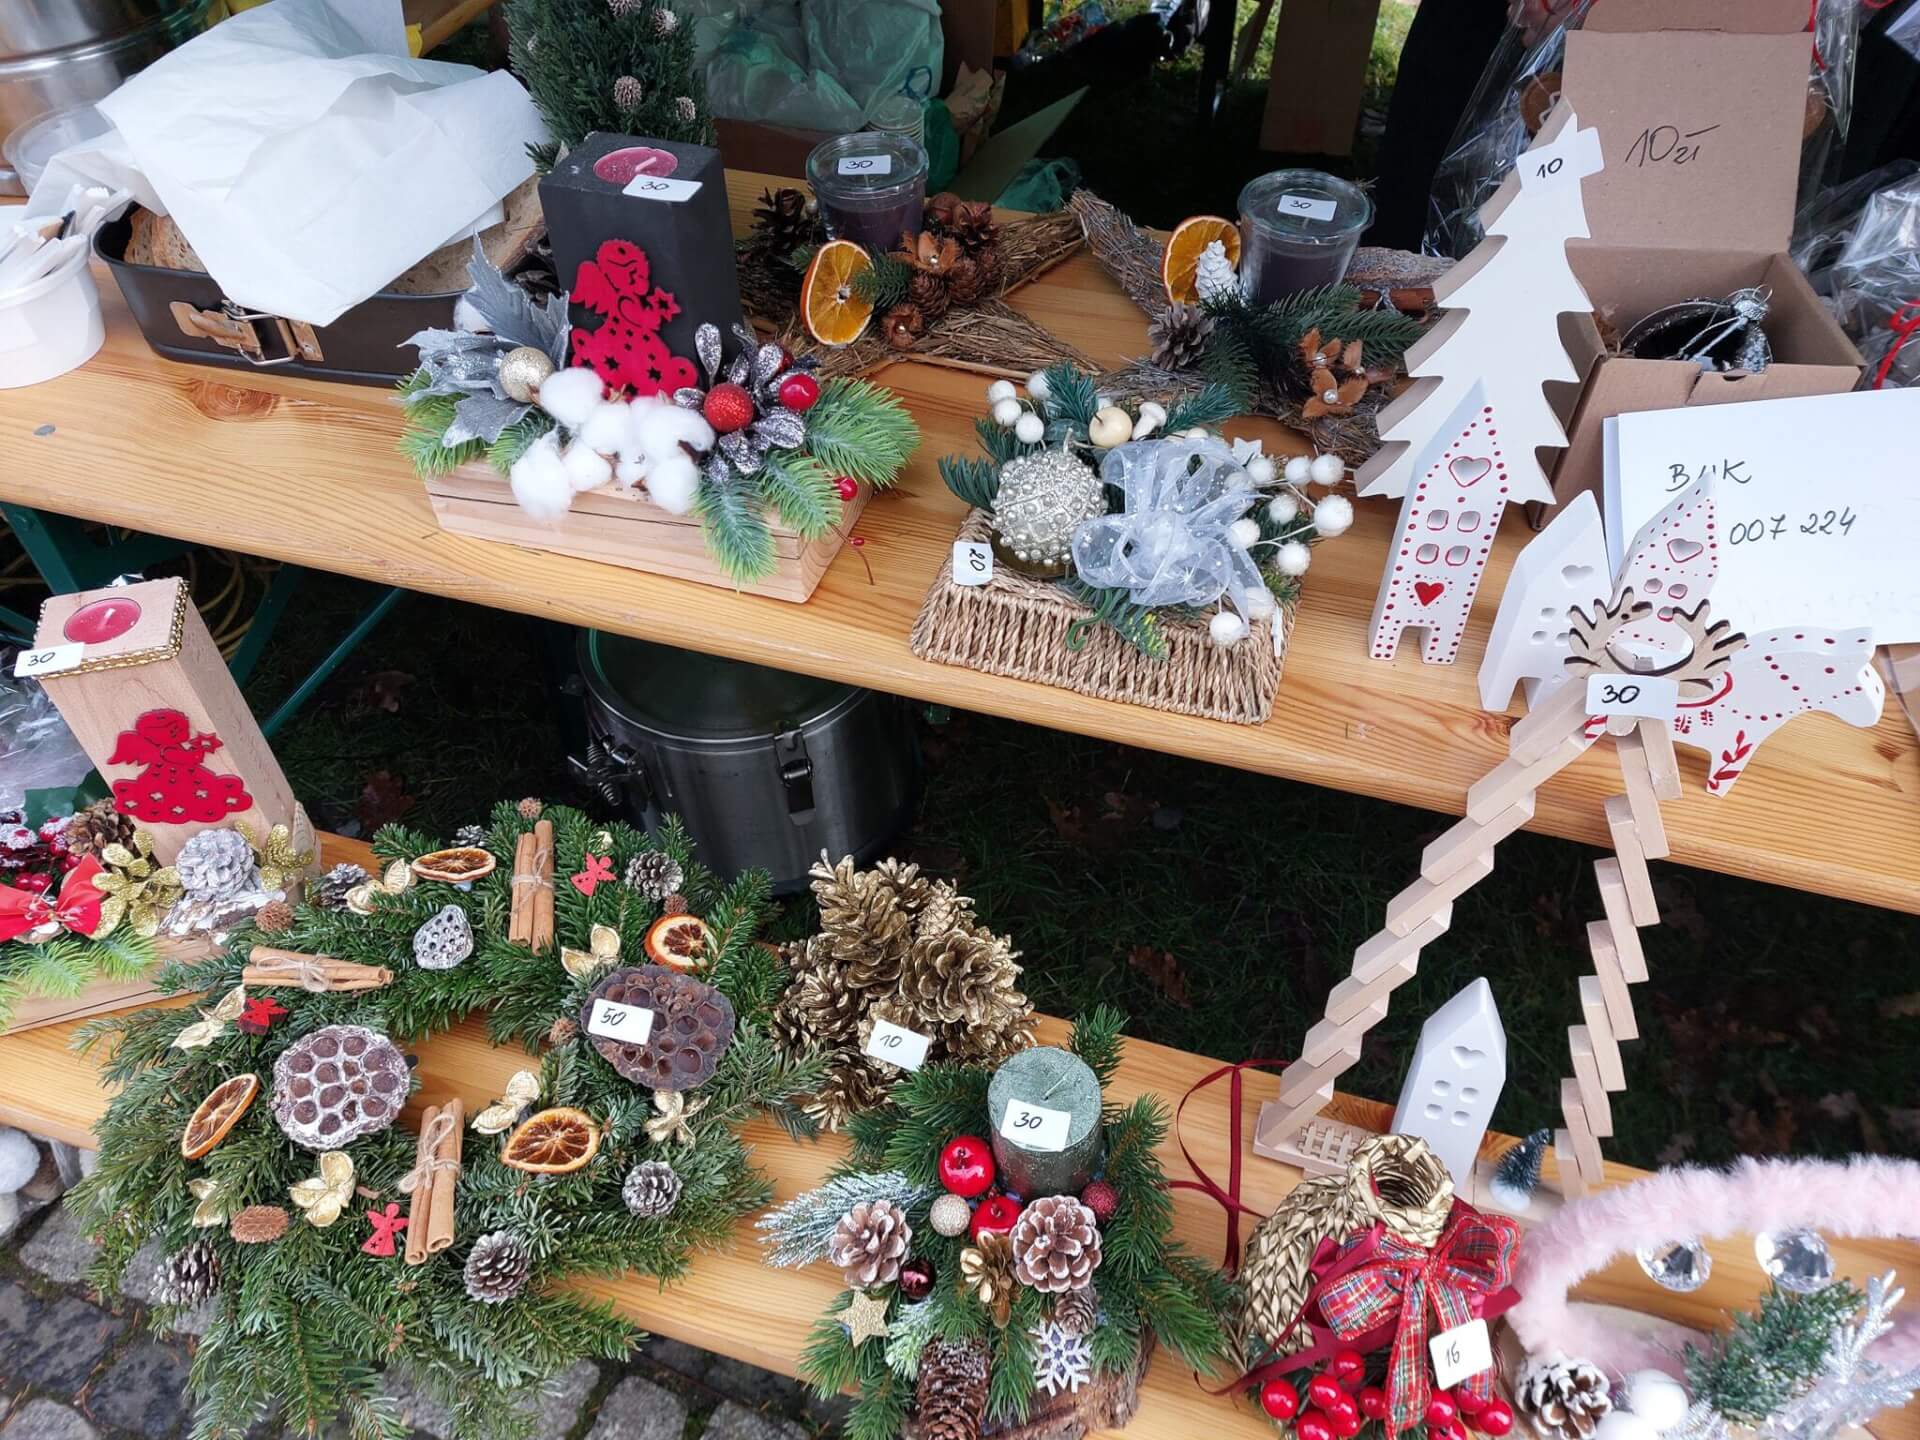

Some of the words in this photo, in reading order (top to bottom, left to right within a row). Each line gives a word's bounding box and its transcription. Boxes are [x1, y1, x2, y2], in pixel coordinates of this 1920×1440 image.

[845, 159, 873, 169] 30
[1536, 157, 1563, 179] 10
[641, 180, 670, 191] 30
[1290, 199, 1313, 209] 30
[1729, 513, 1787, 545] 007
[1799, 506, 1857, 536] 224
[968, 546, 985, 572] 20
[27, 652, 56, 667] 30
[1601, 684, 1641, 705] 30
[600, 1006, 627, 1026] 50
[879, 1034, 903, 1049] 10
[1013, 1111, 1044, 1130] 30
